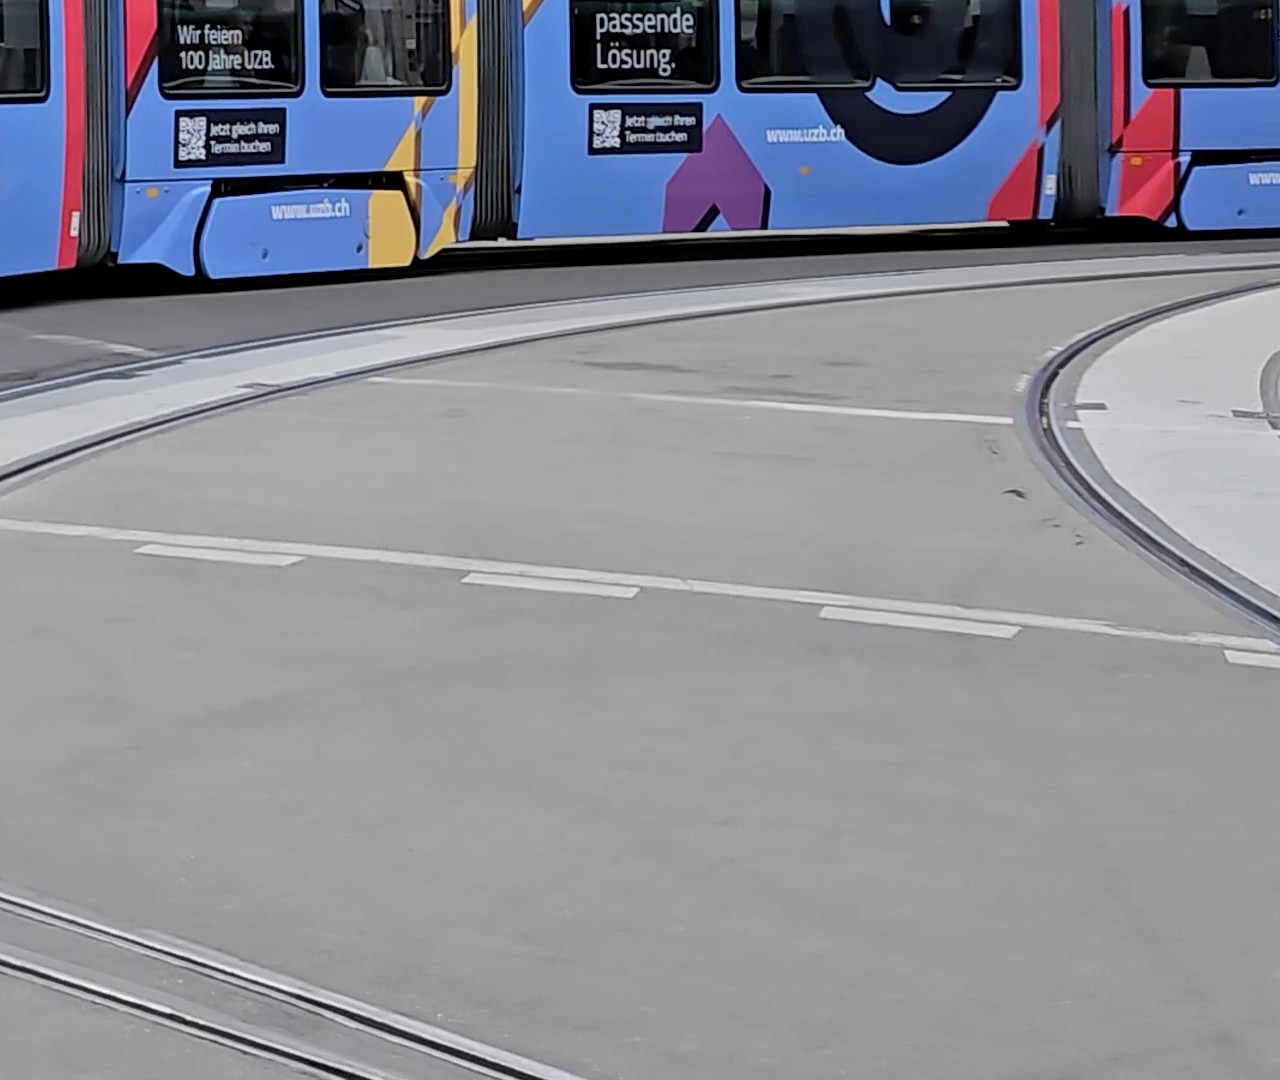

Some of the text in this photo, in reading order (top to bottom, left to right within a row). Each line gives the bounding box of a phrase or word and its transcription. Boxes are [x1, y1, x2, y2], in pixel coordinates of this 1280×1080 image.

[177, 24, 242, 45] Wir feiern
[596, 7, 694, 40] passende
[179, 48, 275, 71] 100 Jahre UZB.
[596, 43, 676, 76] Lösung.
[766, 124, 846, 143] www.uzb.ch
